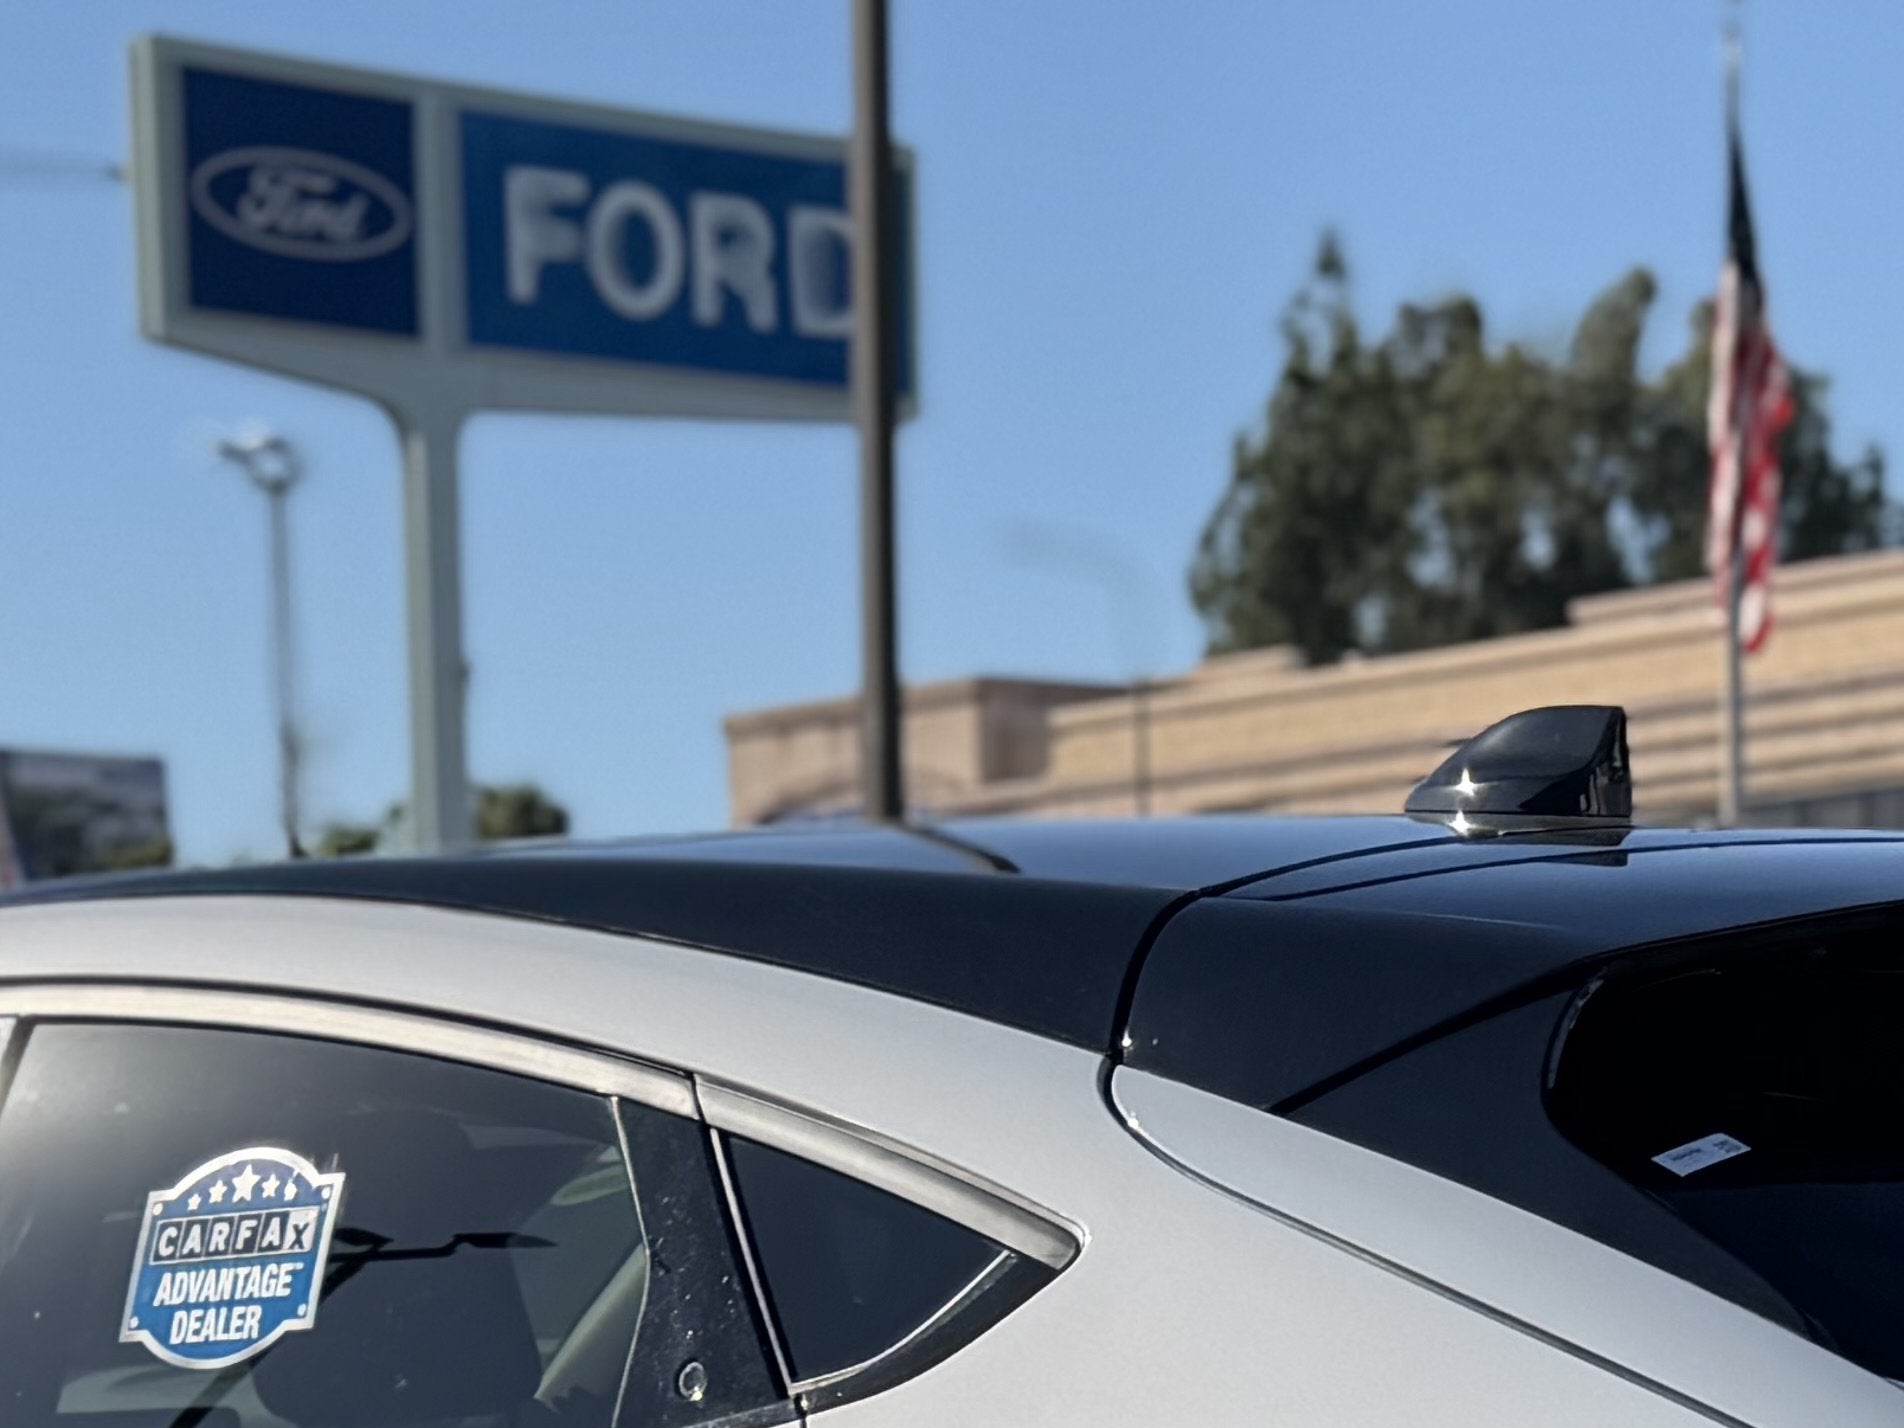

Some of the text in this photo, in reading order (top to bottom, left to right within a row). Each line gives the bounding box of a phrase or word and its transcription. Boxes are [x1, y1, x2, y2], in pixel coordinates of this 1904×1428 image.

[235, 165, 368, 243] Ford
[502, 164, 858, 342] FORD
[158, 1214, 309, 1258] CARFAX
[170, 1307, 262, 1345] DEALER
